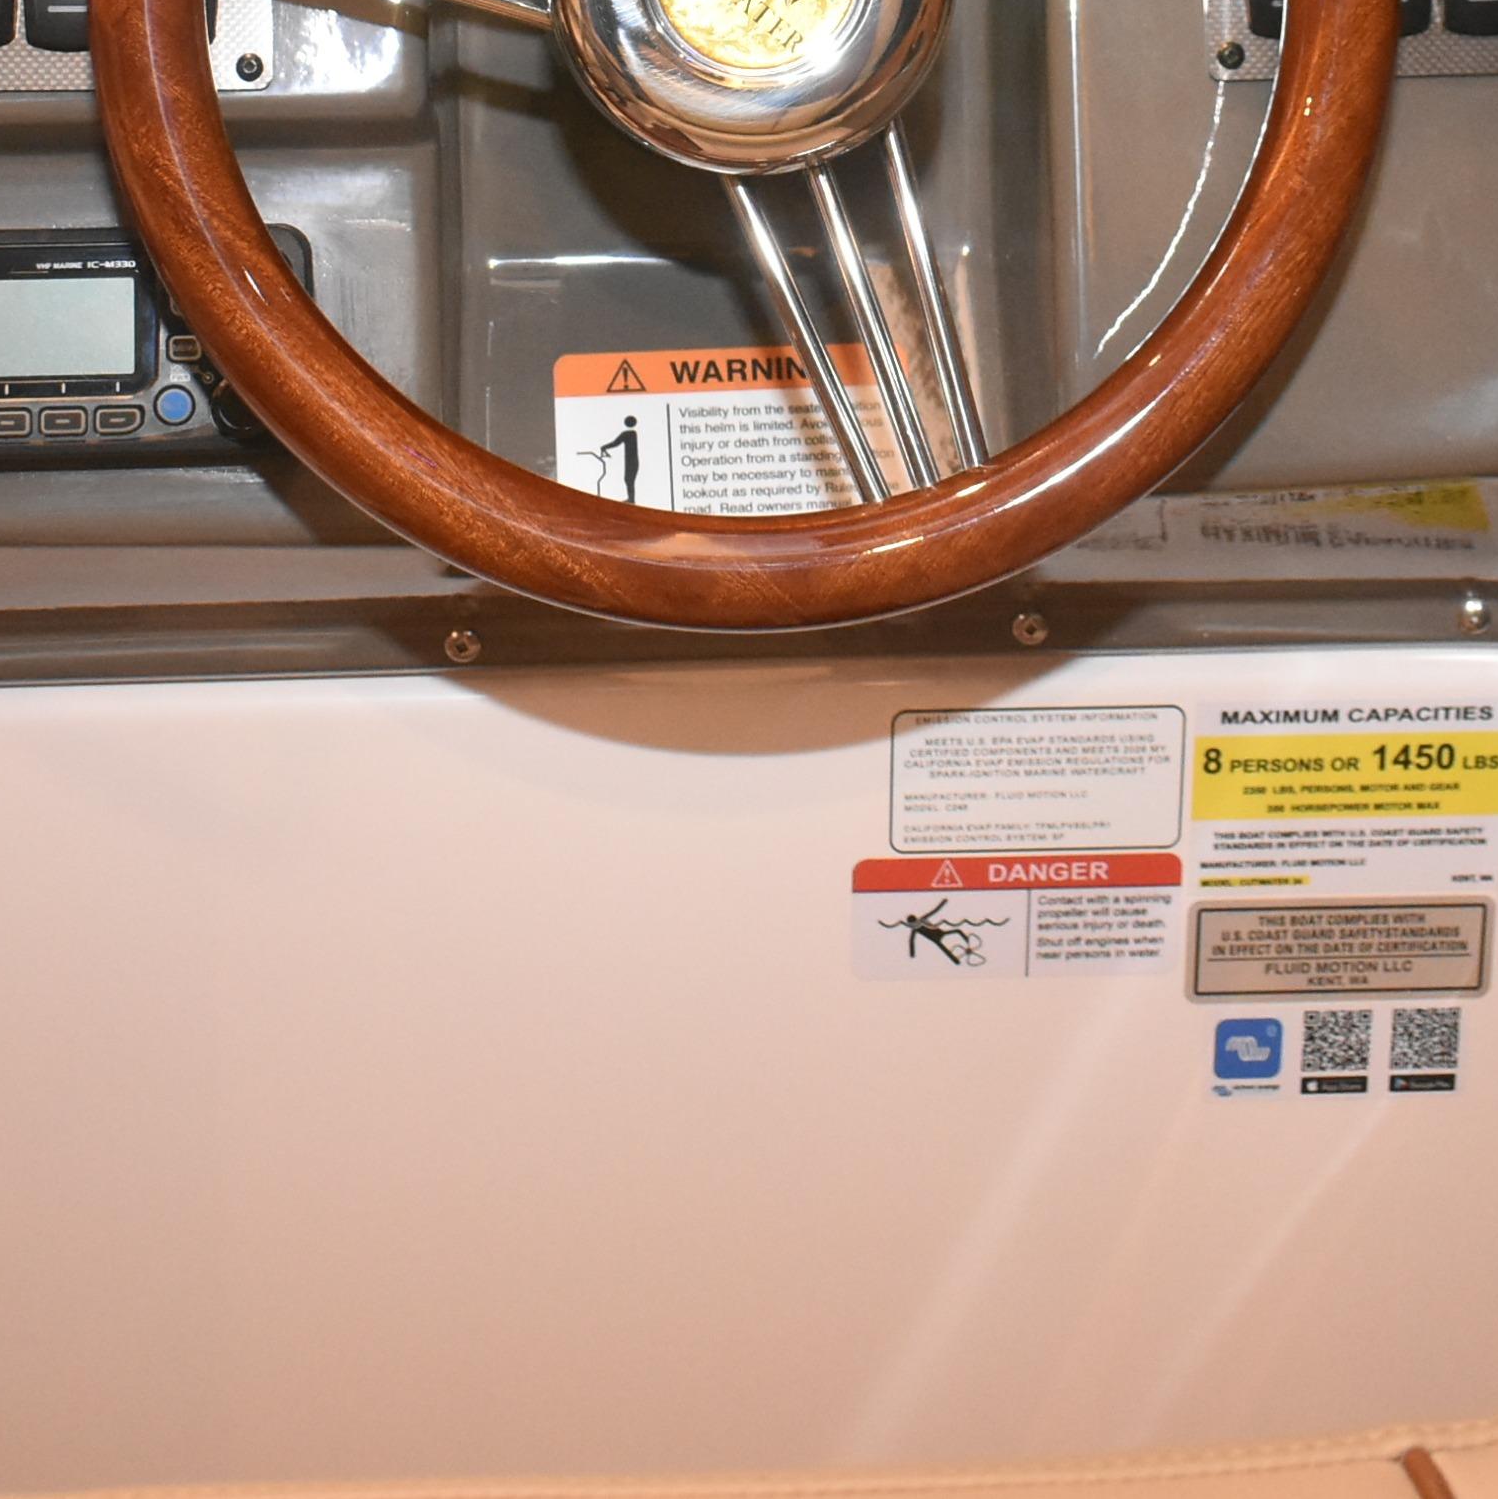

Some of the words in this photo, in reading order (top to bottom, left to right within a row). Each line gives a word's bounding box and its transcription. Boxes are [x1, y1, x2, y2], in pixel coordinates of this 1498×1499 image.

[670, 356, 807, 384] WARNIN
[679, 405, 729, 419] Visibility
[733, 404, 761, 416] from
[765, 404, 784, 415] the
[788, 403, 821, 414] seate
[679, 422, 701, 434] this
[705, 422, 735, 433] helm
[739, 421, 749, 432] is
[680, 438, 714, 452] injury
[717, 439, 729, 449] or
[734, 436, 770, 449] death
[773, 434, 802, 447] from
[681, 453, 742, 467] Operation
[746, 452, 774, 464] from
[778, 454, 786, 464] a
[789, 449, 842, 464] standing
[682, 472, 709, 484] may
[712, 469, 728, 482] be
[731, 470, 796, 483] necessary
[799, 468, 812, 478] to
[682, 486, 728, 499] lookout
[731, 487, 747, 497] as
[751, 483, 802, 497] required
[806, 482, 820, 495] by
[720, 501, 753, 513] Read
[757, 502, 802, 512] owners
[1221, 709, 1339, 725] MAXIMUM
[1348, 705, 1494, 722] CAPACITIES
[1203, 747, 1222, 774] 8
[1230, 757, 1324, 773] PERSONS
[1331, 757, 1361, 772] OR
[1372, 743, 1456, 771] 1450
[988, 861, 1109, 882] DANGER
[1038, 895, 1083, 905] Contact
[1086, 894, 1109, 904] with
[1112, 896, 1120, 904] a
[1123, 893, 1172, 905] spinning
[1037, 908, 1087, 919] propeller
[1091, 907, 1109, 916] will
[1113, 908, 1148, 917] cause
[1258, 915, 1286, 927] THIS
[1290, 914, 1324, 926] BOAT
[1326, 913, 1389, 926] COMPLIES
[1393, 912, 1426, 924] WITH
[1038, 921, 1078, 931] serious
[1083, 920, 1113, 932] injury
[1037, 937, 1063, 947] Shut
[1066, 936, 1082, 945] off
[1084, 936, 1129, 948] engines
[1133, 935, 1164, 945] when
[1221, 930, 1242, 942] U.S.
[1248, 929, 1289, 941] COAST
[1292, 928, 1335, 940] GUARD
[1036, 952, 1062, 960] near
[1065, 950, 1111, 961] persons
[1115, 950, 1126, 958] in
[1212, 945, 1226, 956] IN
[1229, 944, 1271, 956] EFFECT
[1275, 943, 1293, 955] ON
[1296, 942, 1319, 954] THE
[1322, 942, 1355, 954] DATE
[1358, 942, 1374, 953] OF
[1377, 940, 1468, 953] CERTIFICATION
[1264, 963, 1311, 975] FLUID
[1316, 961, 1378, 974] MOTION
[1383, 960, 1413, 973] LLC
